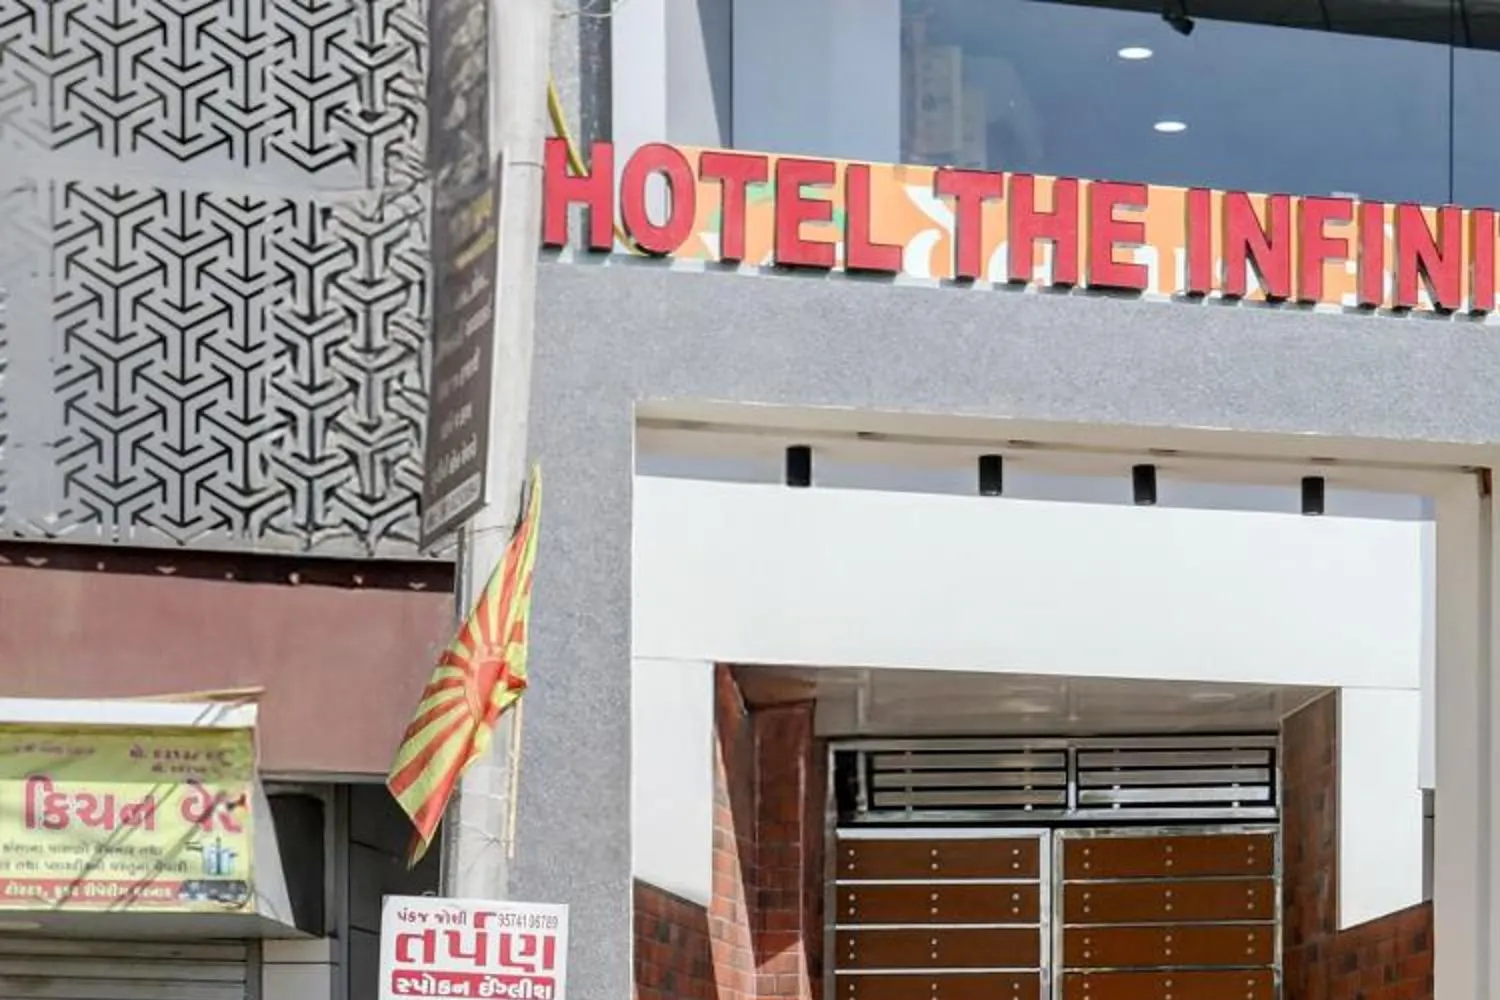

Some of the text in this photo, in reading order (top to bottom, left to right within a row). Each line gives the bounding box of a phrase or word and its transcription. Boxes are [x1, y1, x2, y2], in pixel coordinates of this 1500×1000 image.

[543, 137, 903, 275] HOTEL
[934, 166, 1148, 292] THE
[395, 911, 556, 973] તર્પણ
